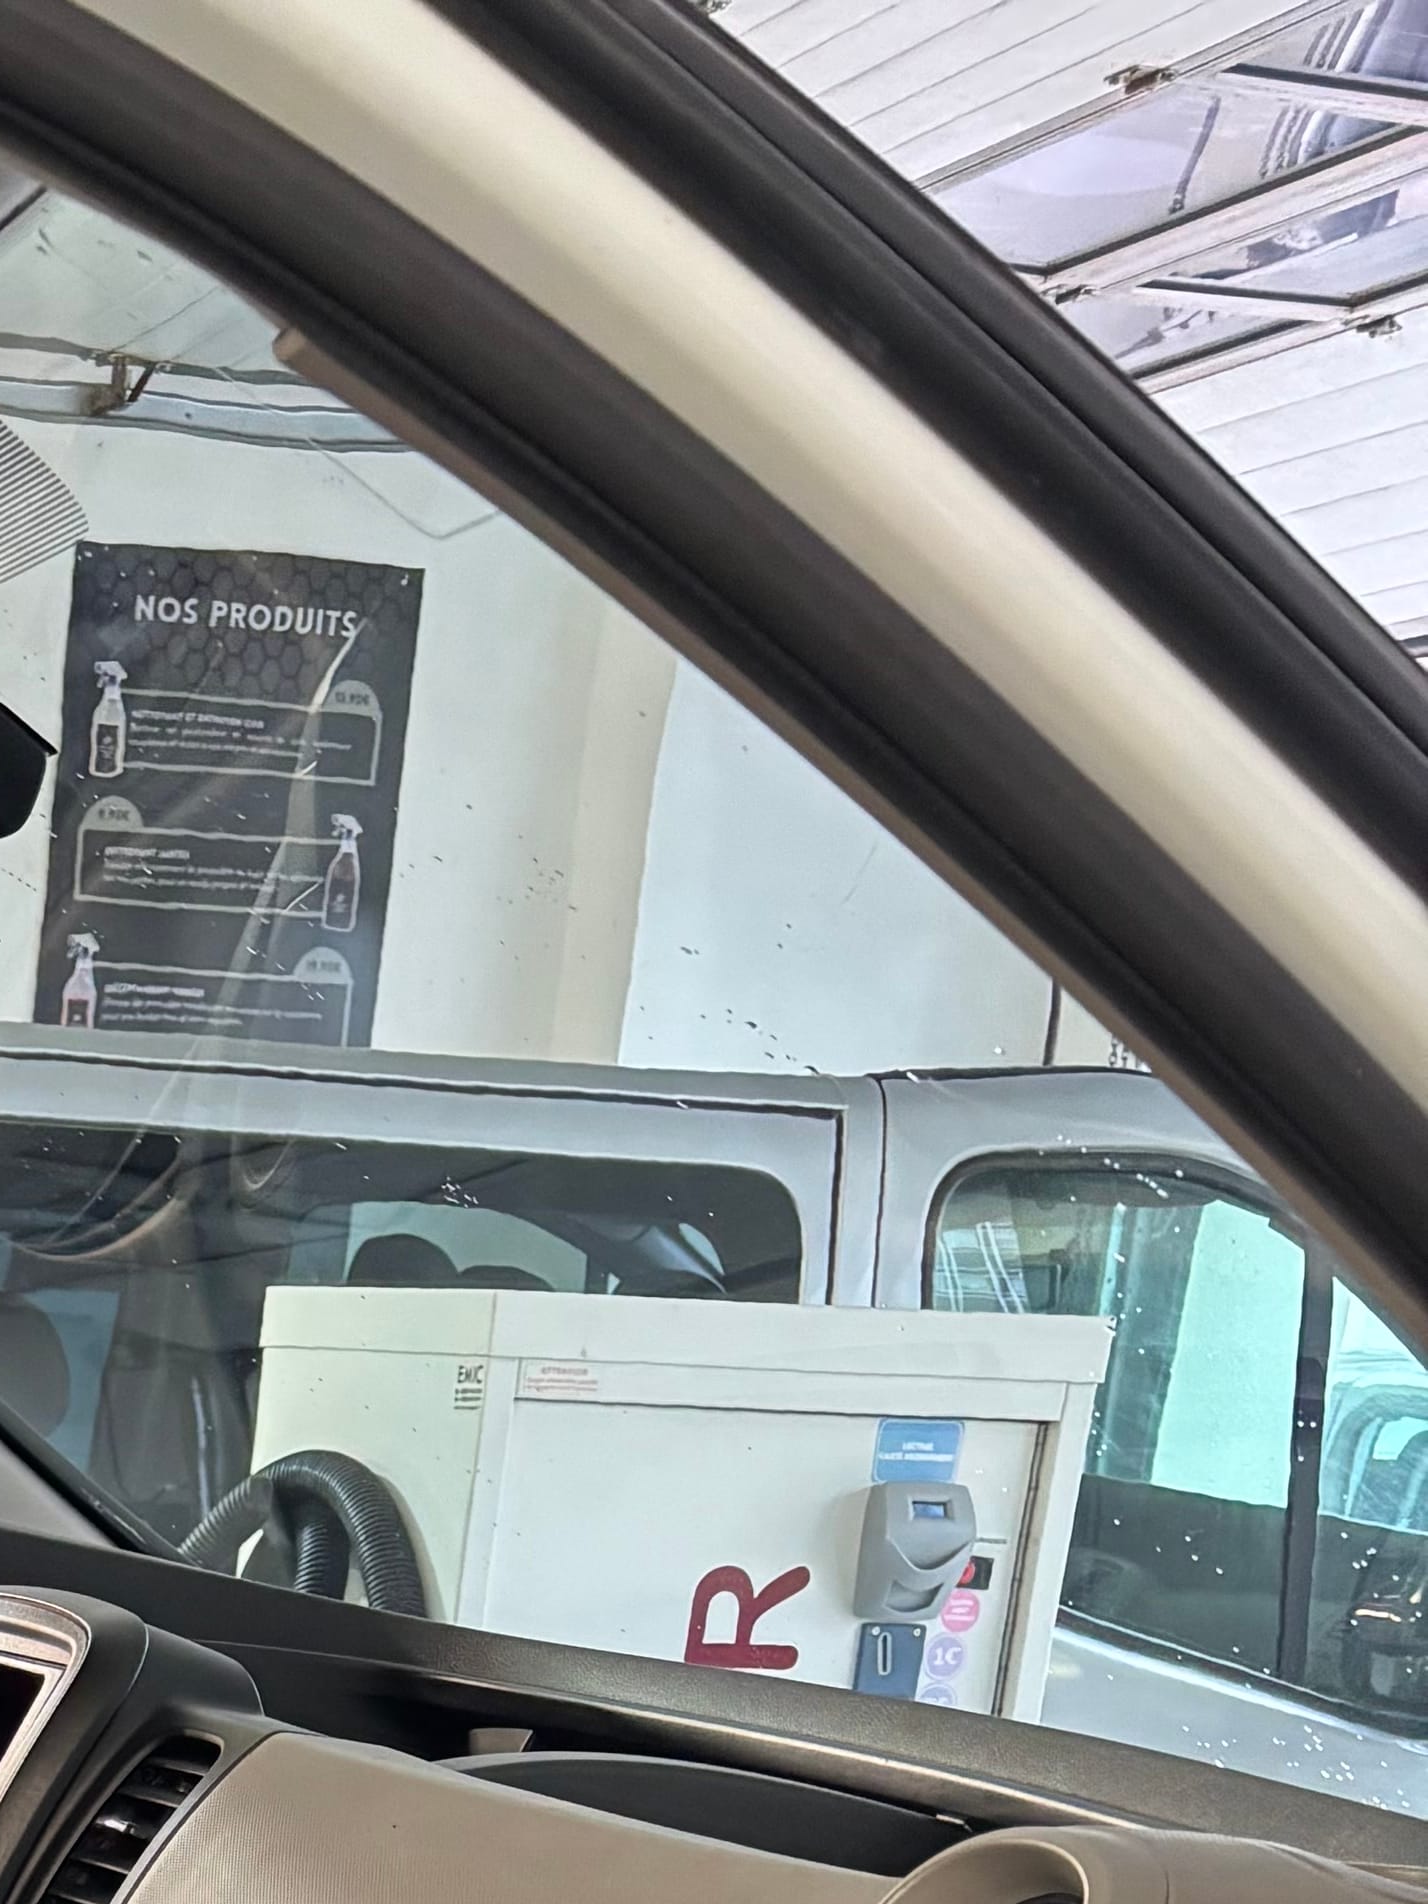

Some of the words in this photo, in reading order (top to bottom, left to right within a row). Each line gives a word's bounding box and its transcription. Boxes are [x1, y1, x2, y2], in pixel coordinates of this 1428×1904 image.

[134, 595, 198, 627] NOS
[208, 600, 359, 639] PRODUITS
[684, 1565, 811, 1671] R
